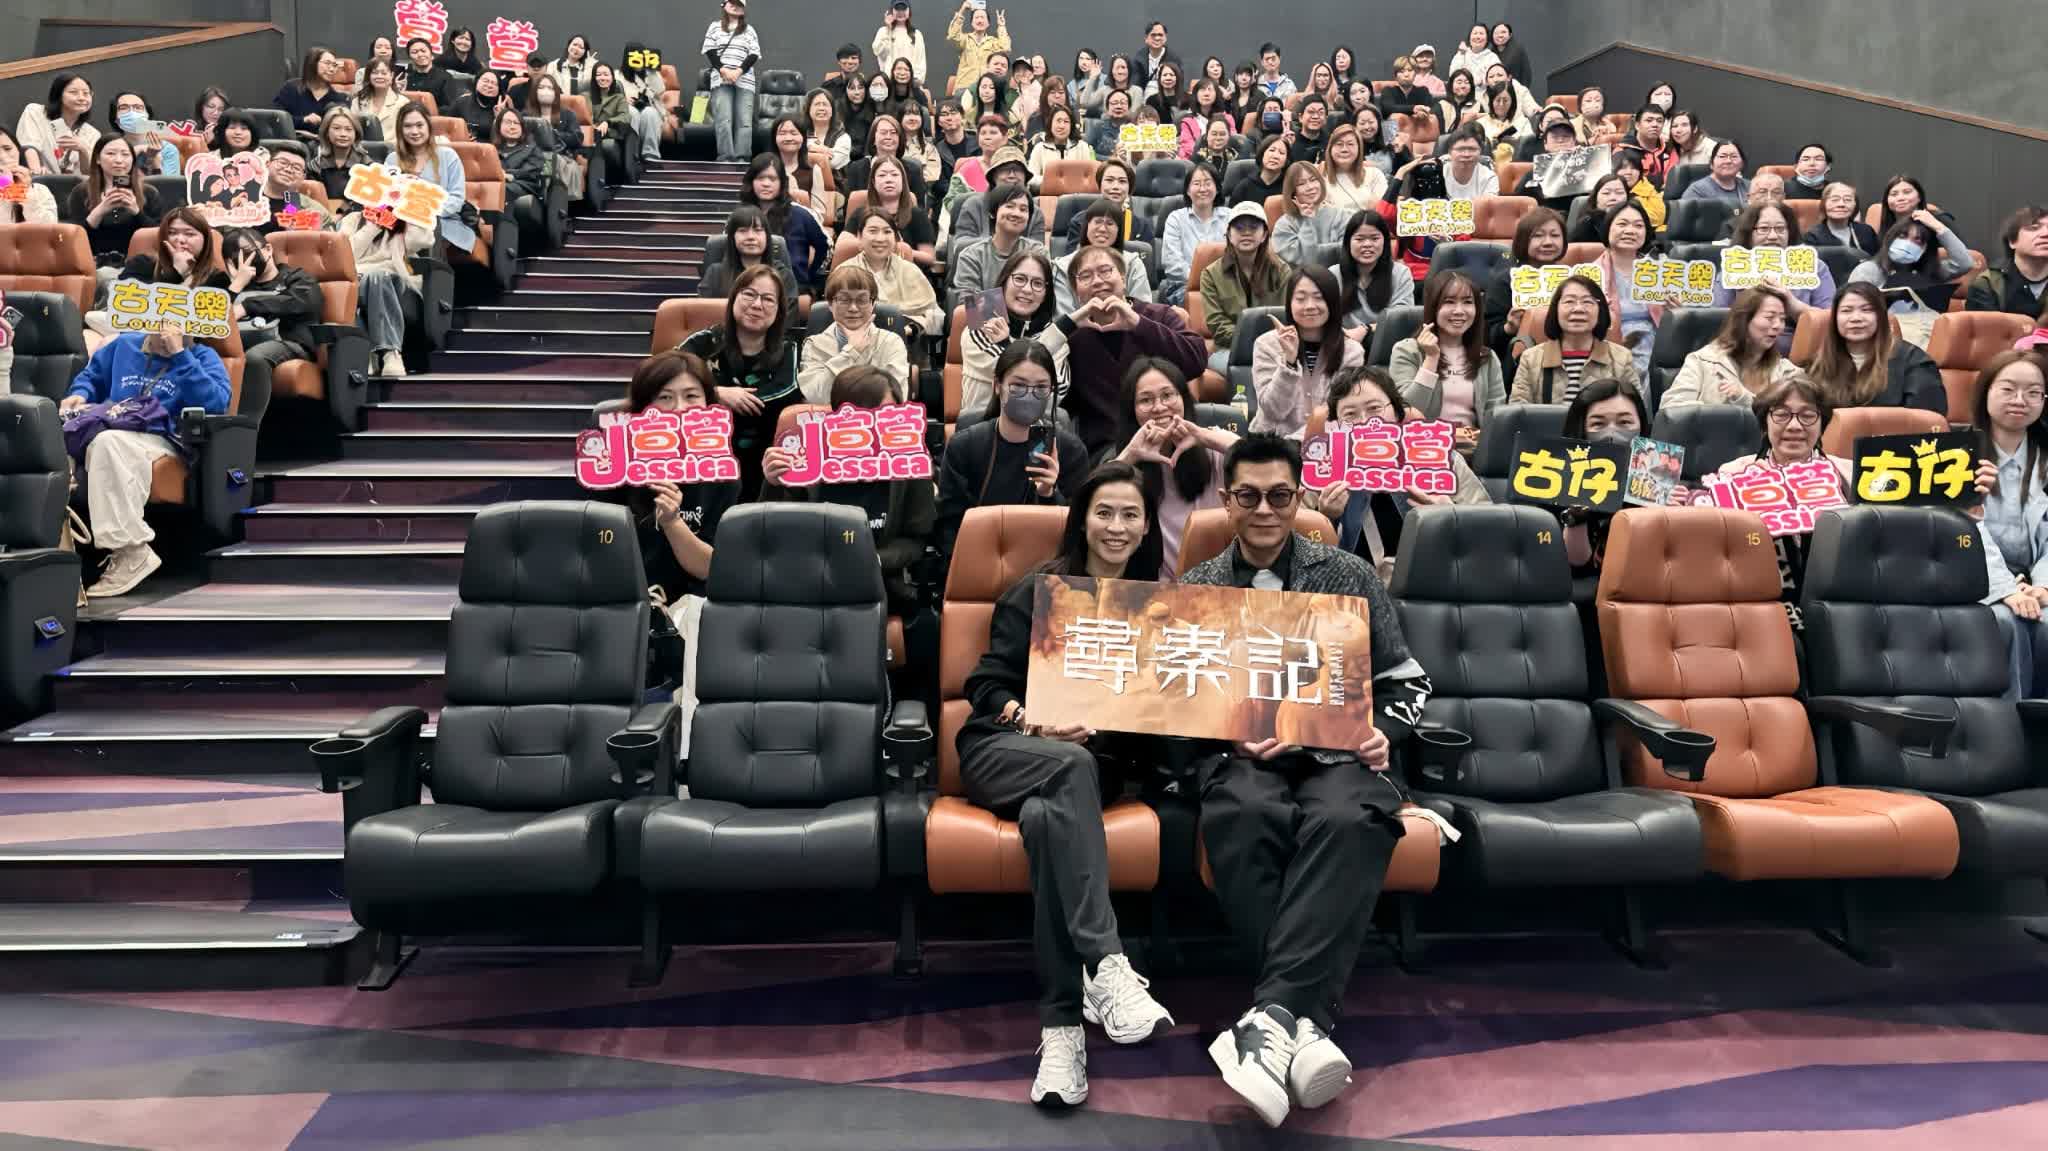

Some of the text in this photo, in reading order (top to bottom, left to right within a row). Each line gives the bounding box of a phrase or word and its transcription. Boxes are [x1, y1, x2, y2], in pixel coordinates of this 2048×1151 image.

[1400, 201, 1473, 223] 古天樂
[1634, 261, 1714, 290] 古天樂
[1725, 248, 1815, 273] 古天樂
[113, 283, 227, 320] 古天樂
[184, 320, 229, 336] Koo
[15, 414, 22, 424] 7
[629, 407, 732, 459] 宣萱
[824, 406, 924, 457] 宣萱
[578, 424, 738, 487] Jessica
[779, 422, 932, 485] Jessica
[1352, 420, 1452, 469] 宣萱
[1302, 432, 1457, 491] Jessica
[1513, 447, 1619, 505] 古仔
[1857, 447, 1975, 502] 古仔
[1733, 462, 1841, 512] 宣萱
[598, 530, 614, 544] 10
[843, 530, 855, 544] 11
[1307, 530, 1322, 542] 13
[1536, 531, 1552, 545] 14
[1746, 533, 1761, 546] 15
[1956, 534, 1972, 548] 16
[1056, 616, 1322, 704] 尋秦記
